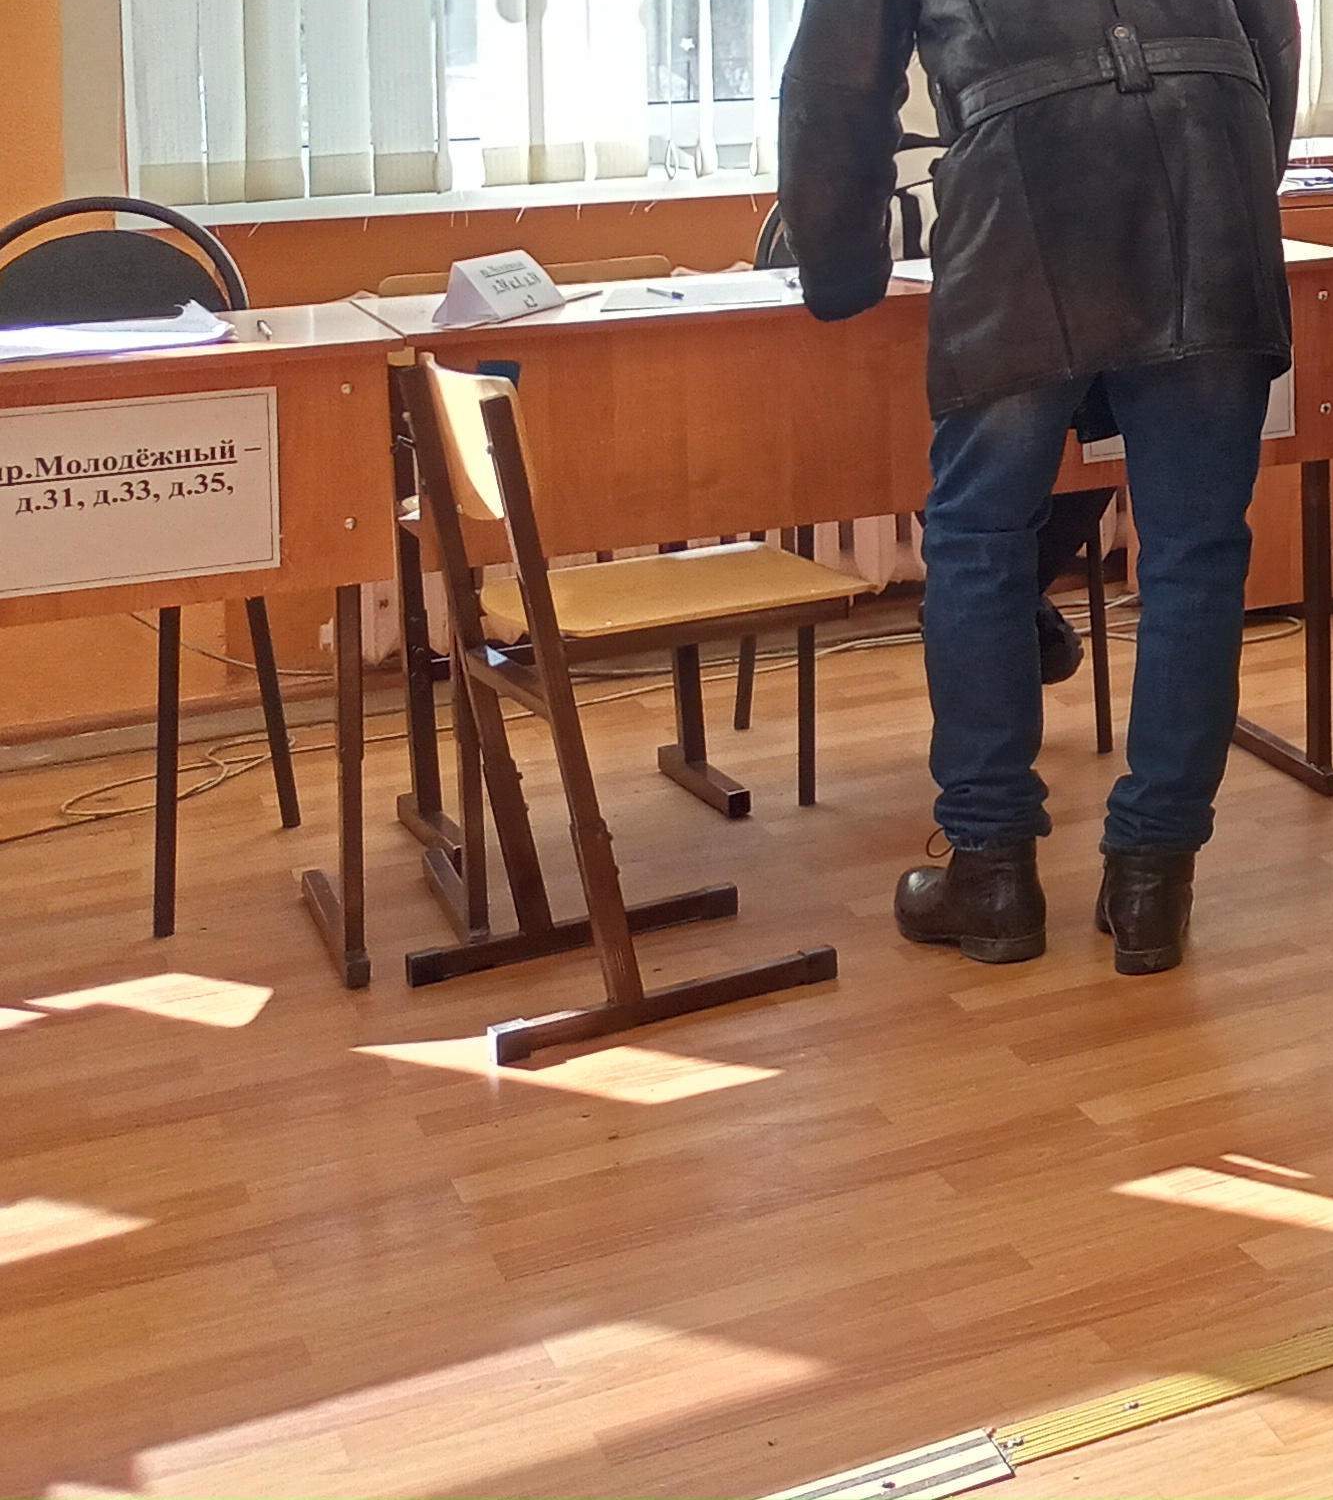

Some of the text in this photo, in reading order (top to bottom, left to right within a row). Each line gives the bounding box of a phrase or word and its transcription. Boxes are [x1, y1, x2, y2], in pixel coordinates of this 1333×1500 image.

[0, 438, 237, 484] р.Молодёжный
[15, 471, 235, 516] д.31, д.33, д.35,
